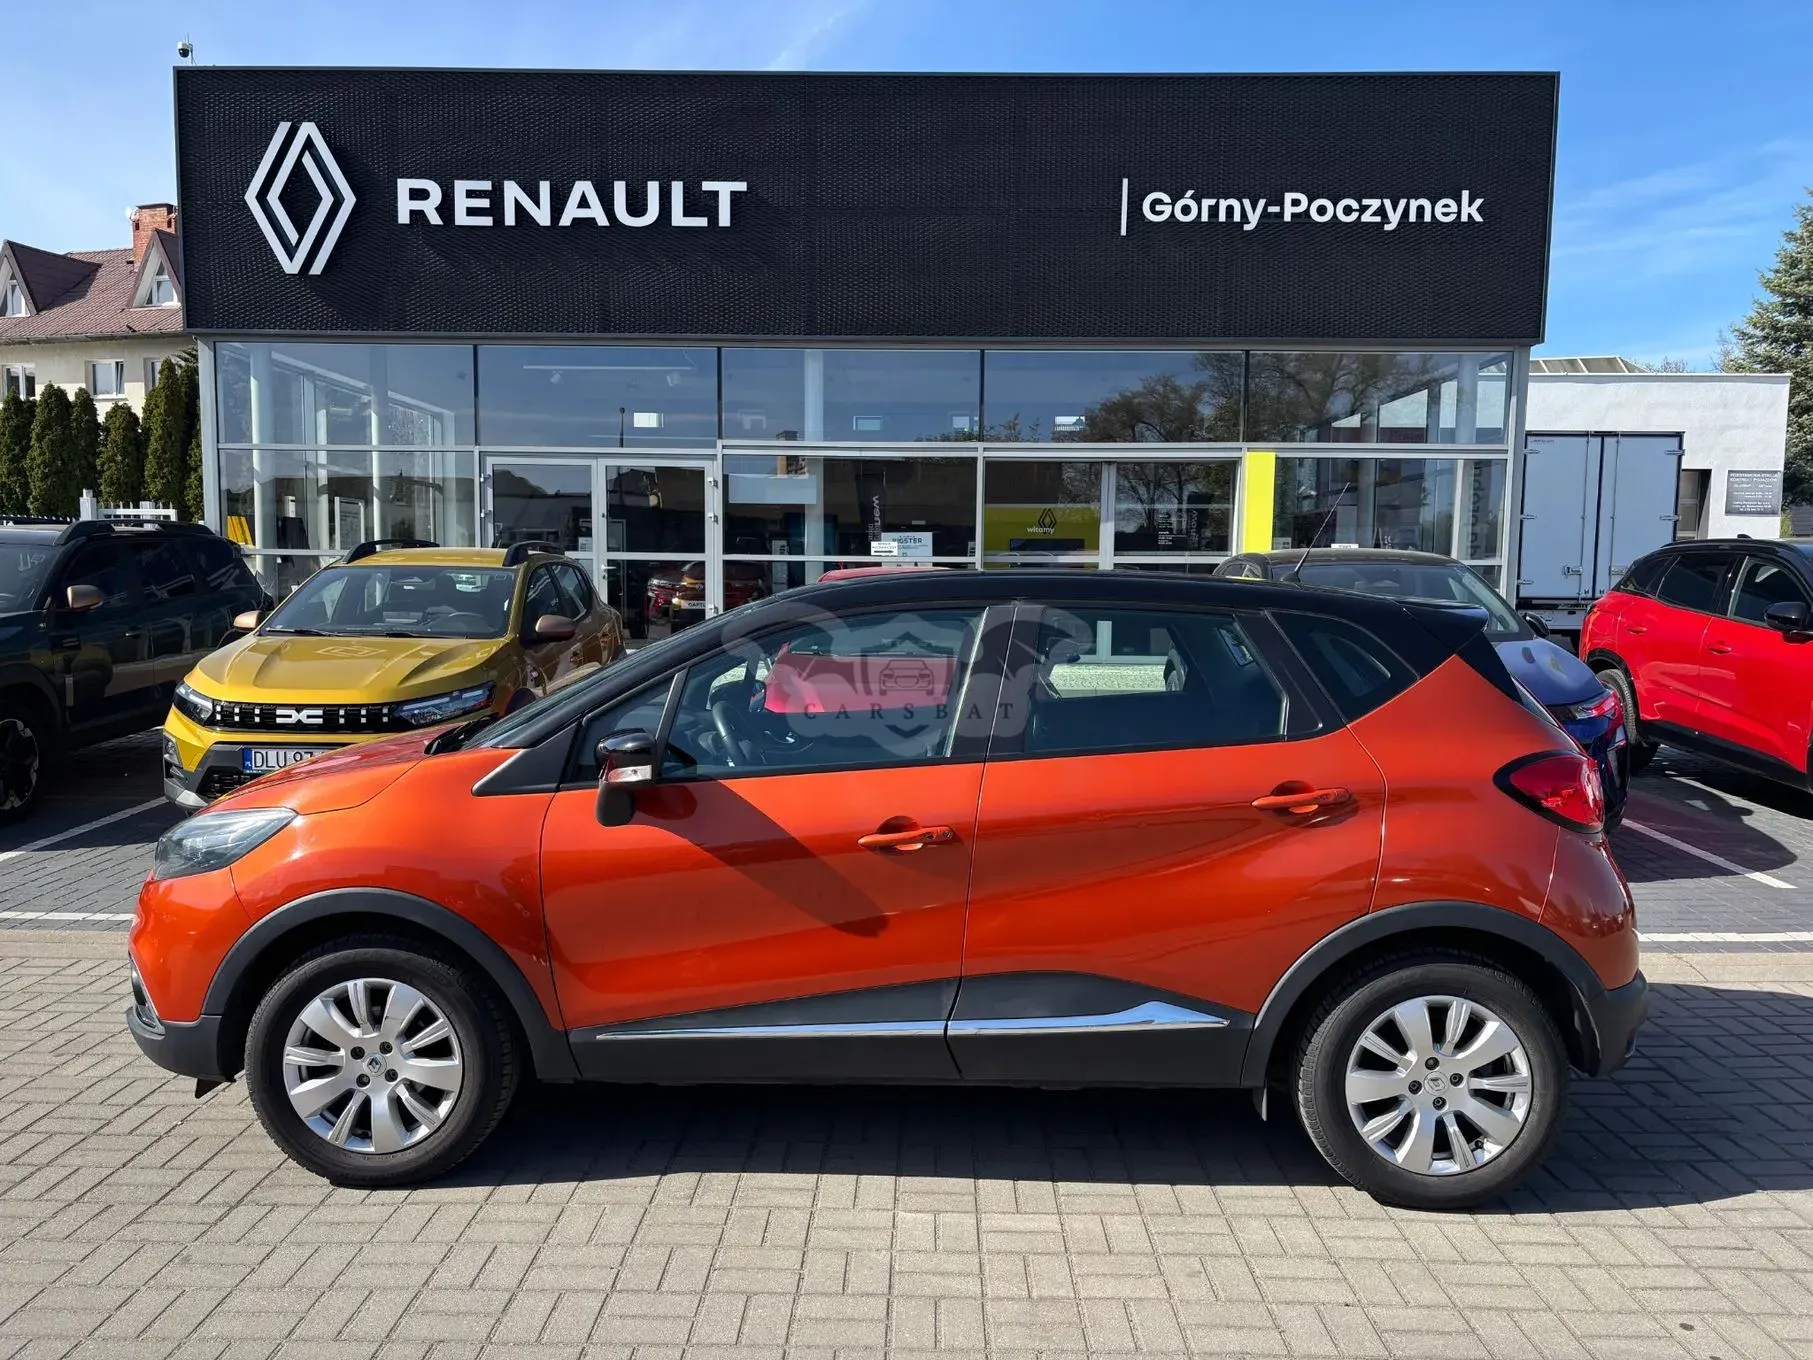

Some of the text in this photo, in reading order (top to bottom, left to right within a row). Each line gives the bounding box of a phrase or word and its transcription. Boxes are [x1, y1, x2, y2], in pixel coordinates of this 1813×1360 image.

[397, 179, 748, 227] RENAULT
[1142, 189, 1485, 231] Górny-Poczynek
[1026, 525, 1055, 534] witamy
[254, 751, 287, 769] DLU
